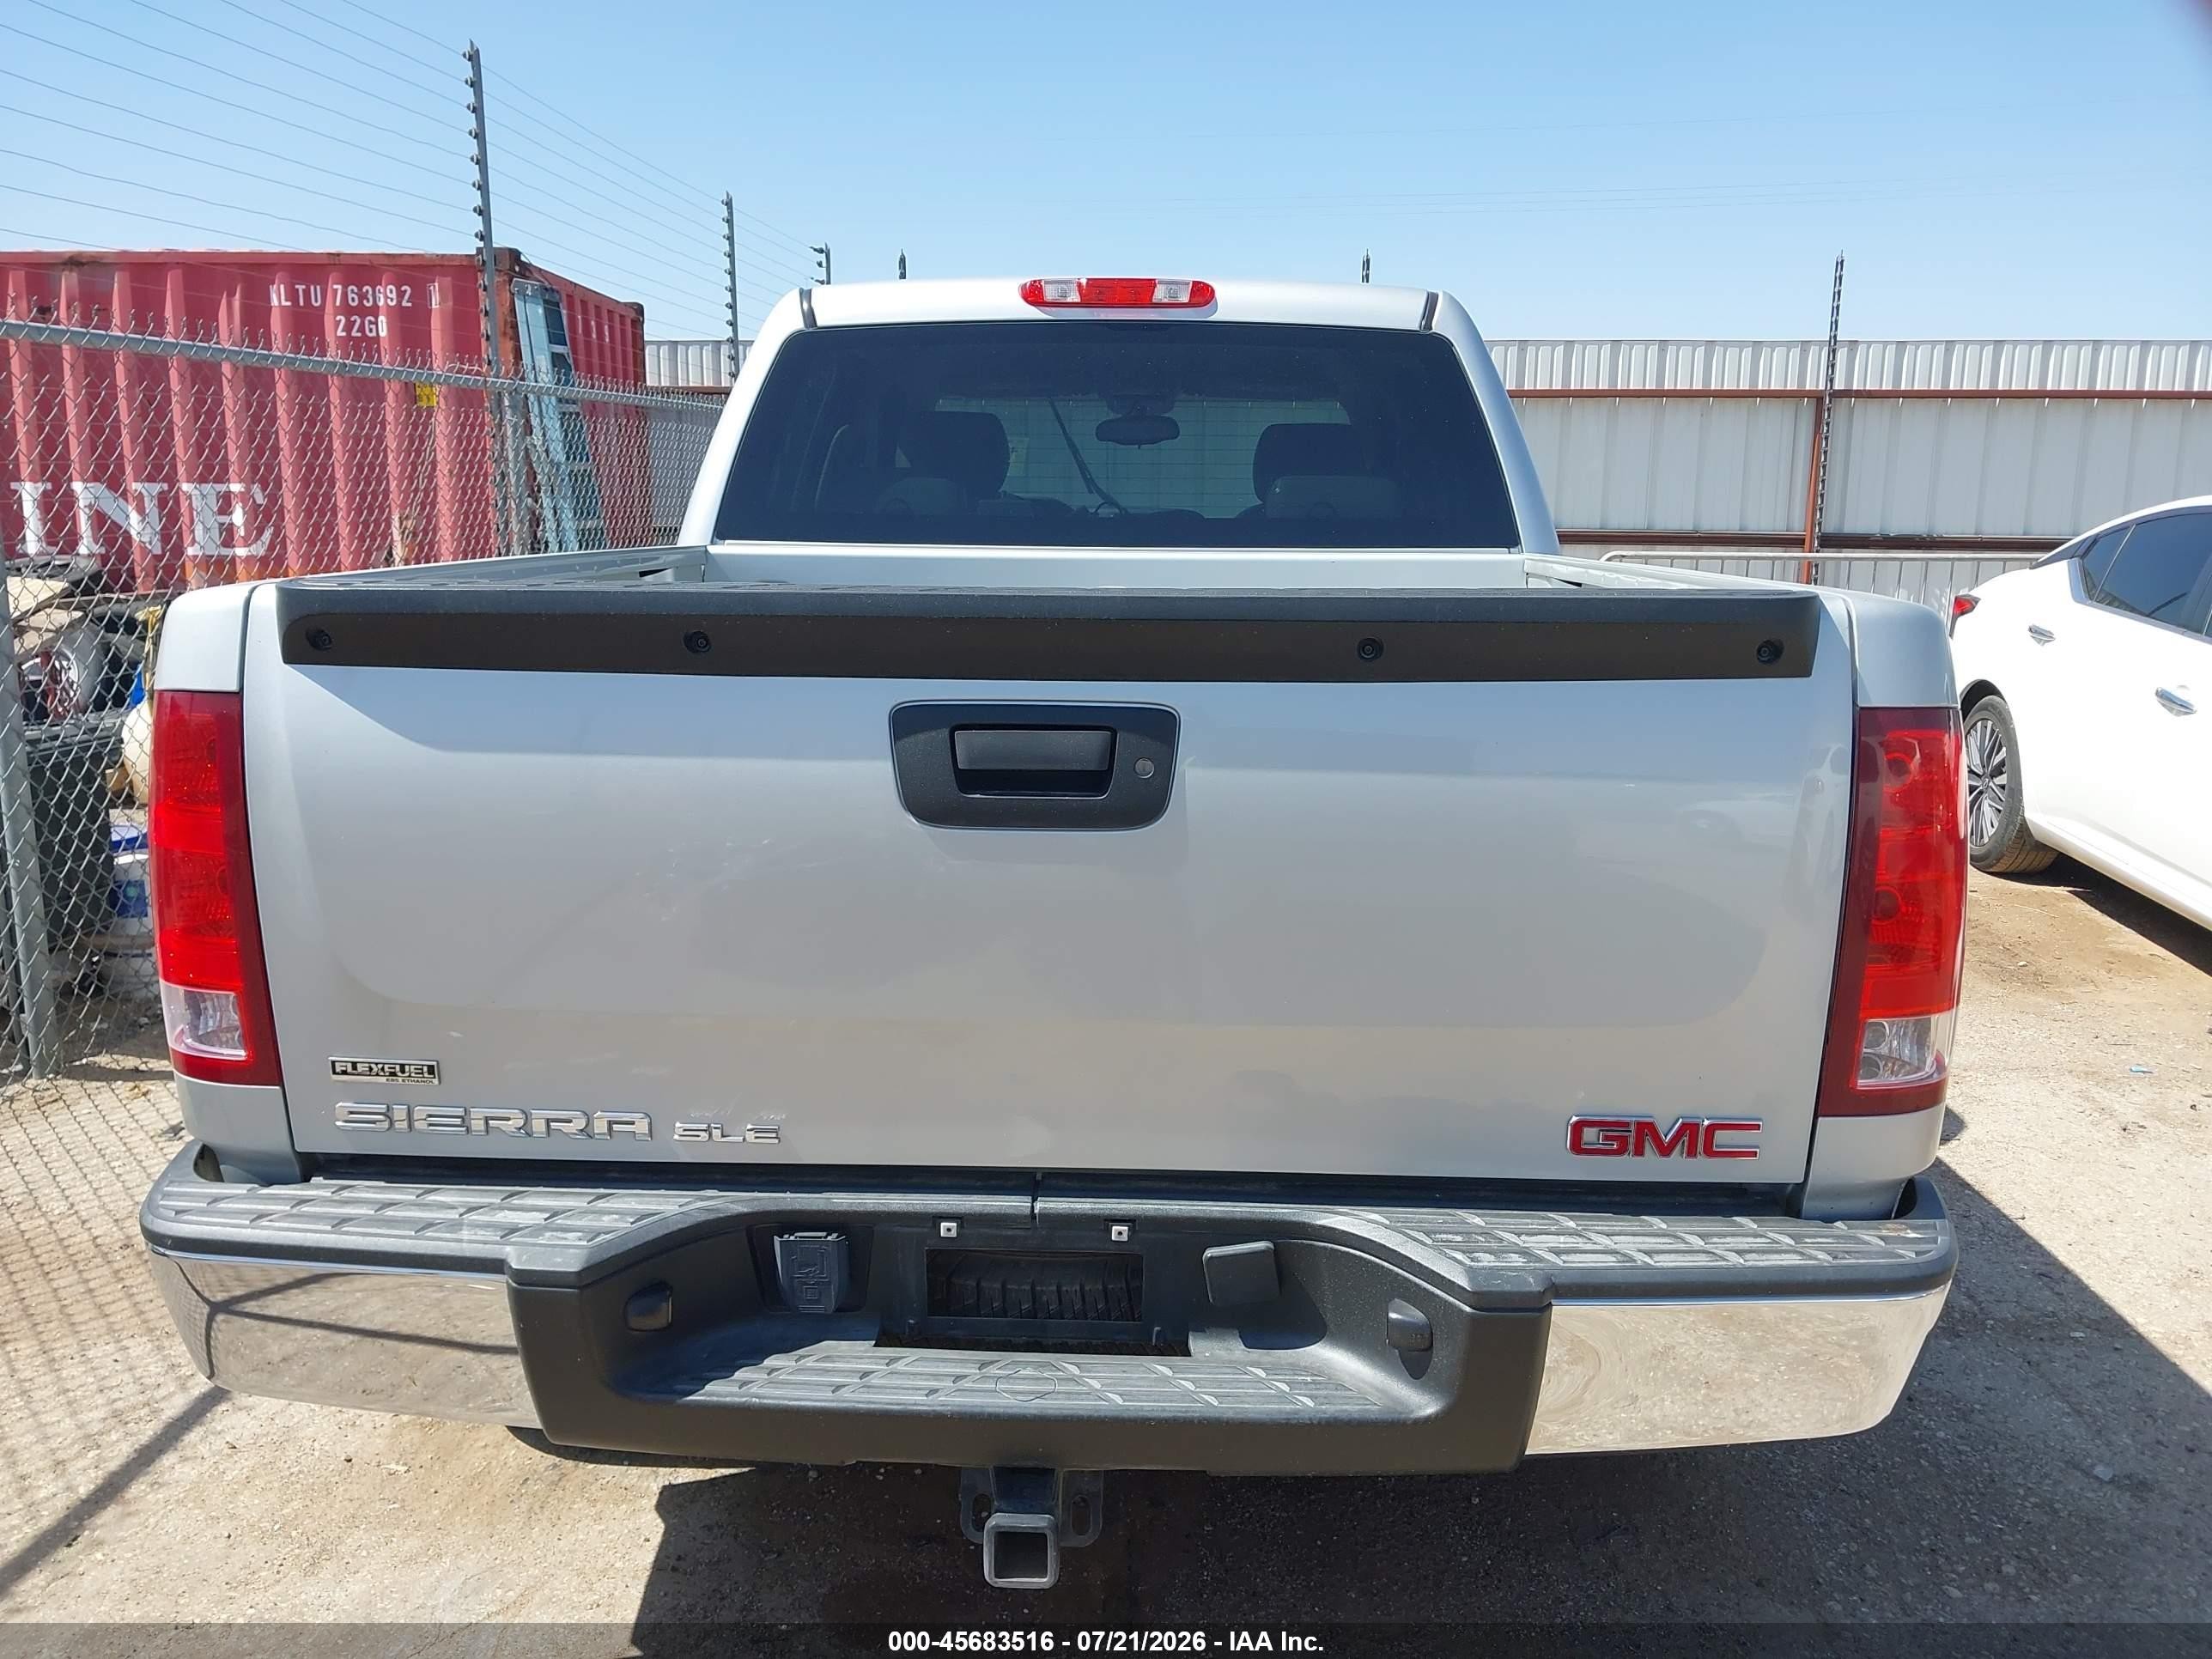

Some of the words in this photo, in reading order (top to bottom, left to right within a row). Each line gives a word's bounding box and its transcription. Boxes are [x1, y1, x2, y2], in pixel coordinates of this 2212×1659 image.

[332, 284, 412, 307] 763692
[334, 1061, 434, 1078] FLEXFUEL
[334, 1102, 652, 1141] SIERRA
[673, 1121, 781, 1144] SLE
[1567, 1115, 1763, 1160] GMC
